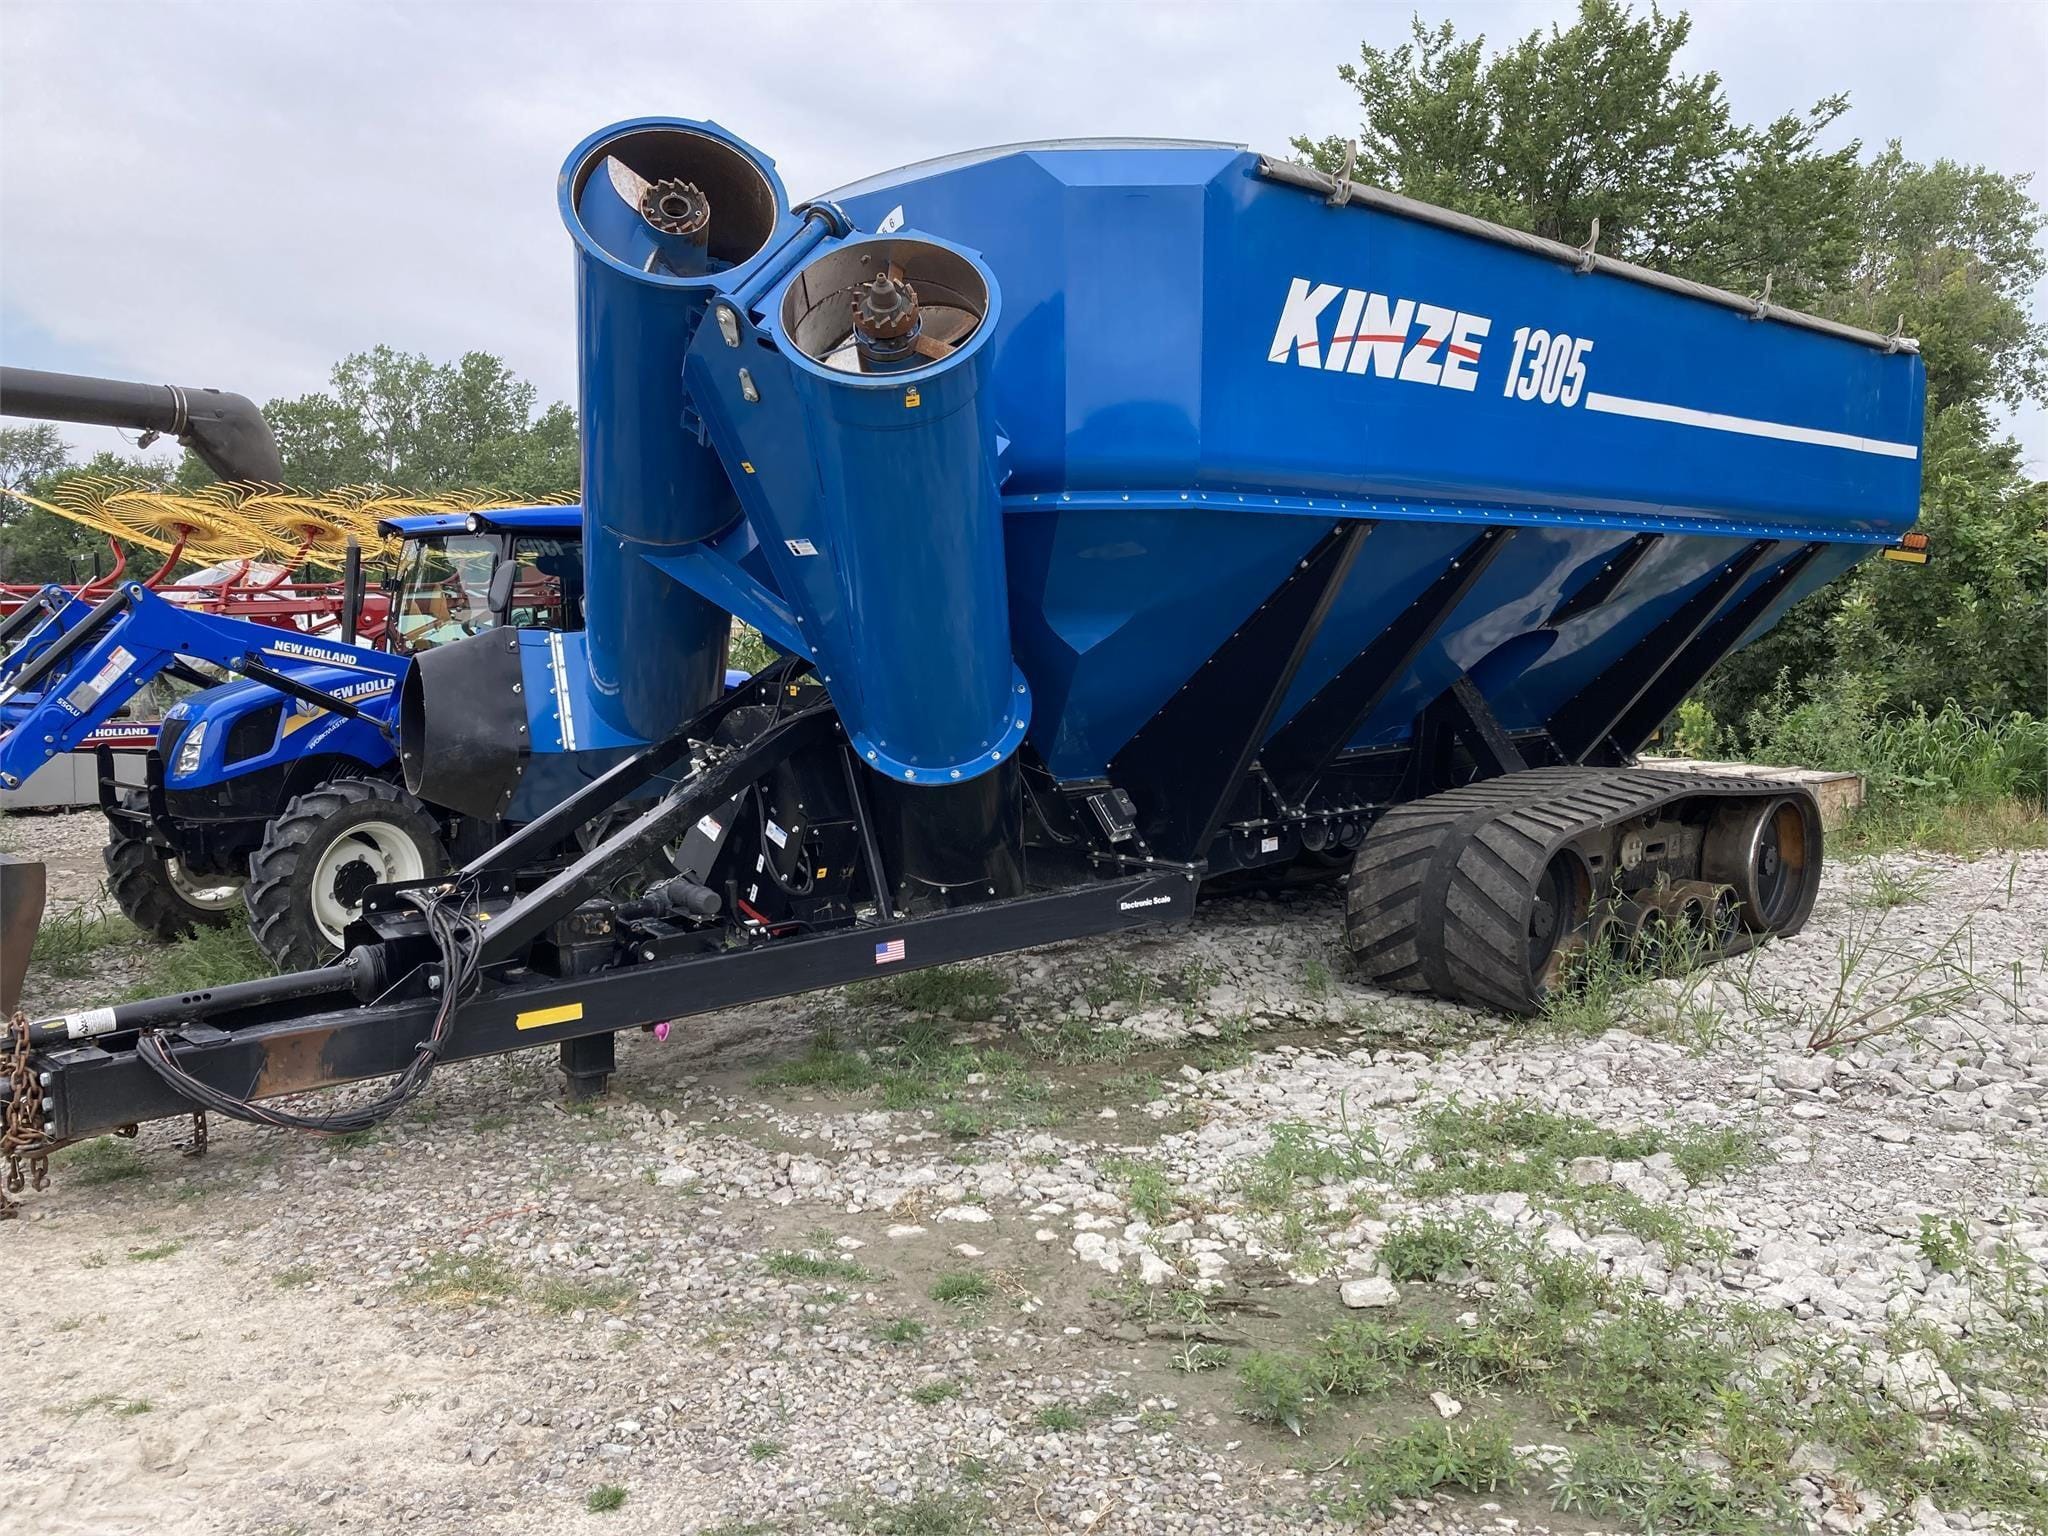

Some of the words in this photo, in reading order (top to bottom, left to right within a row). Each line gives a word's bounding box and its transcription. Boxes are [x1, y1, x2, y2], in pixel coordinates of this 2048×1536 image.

[1267, 277, 1492, 392] KINZE
[1503, 326, 1594, 408] 1305
[274, 640, 302, 654] NEW
[303, 646, 357, 665] HOLLAND
[95, 727, 149, 737] HOLLAND
[1120, 898, 1153, 910] Electronic
[1153, 895, 1171, 904] Scale
